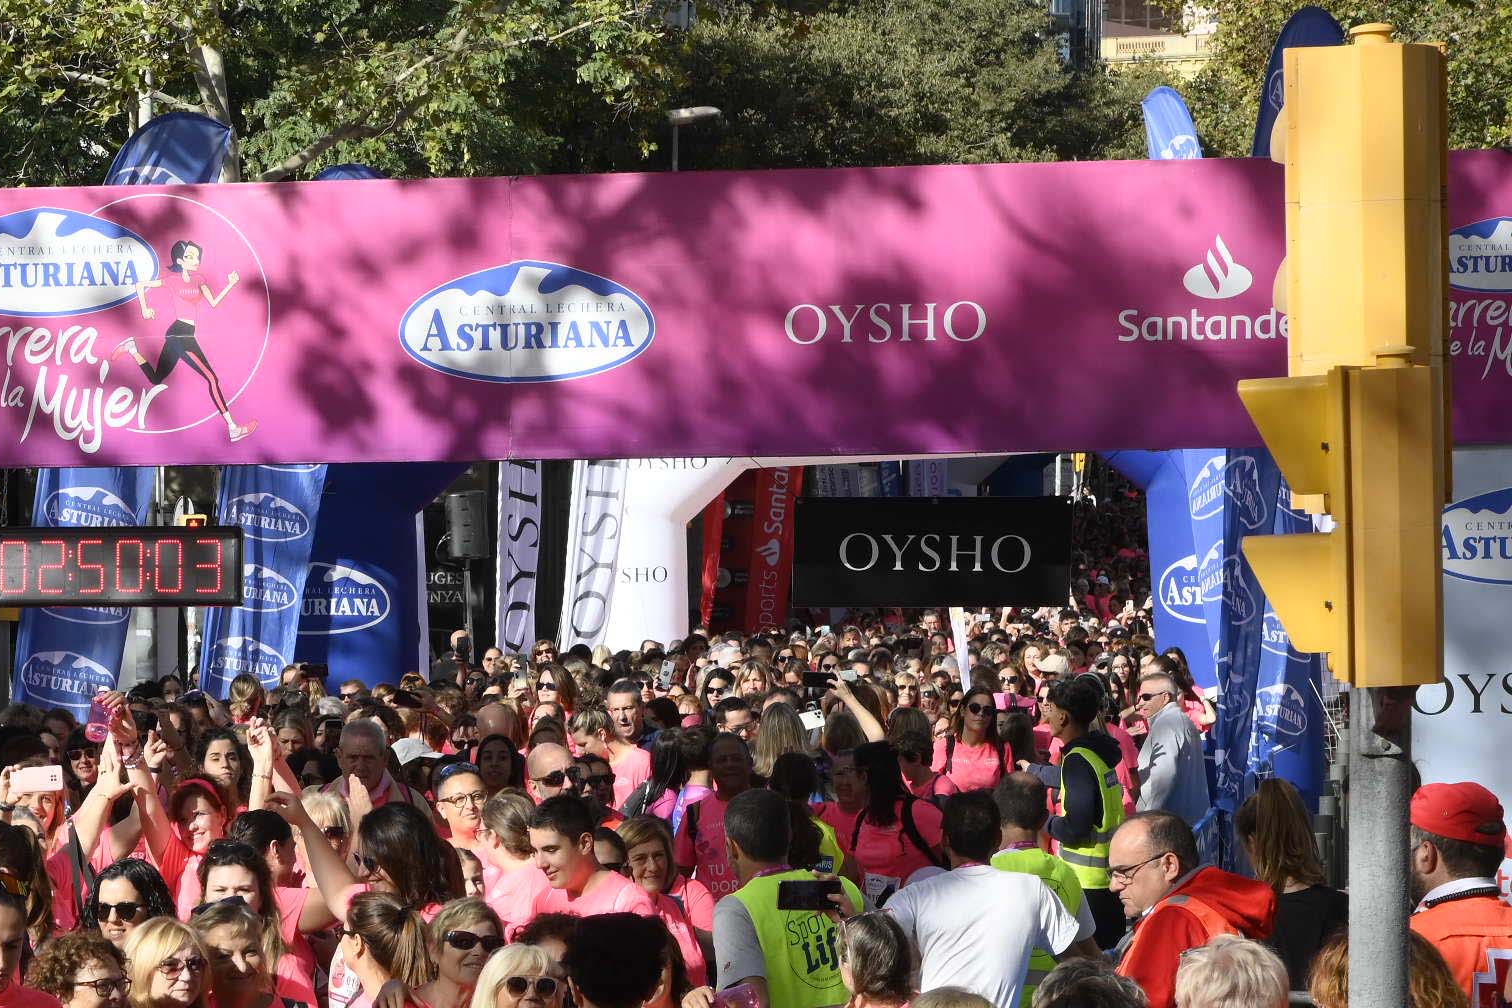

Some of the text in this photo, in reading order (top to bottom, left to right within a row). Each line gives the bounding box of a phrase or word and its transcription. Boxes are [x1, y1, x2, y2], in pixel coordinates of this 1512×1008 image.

[459, 301, 627, 315] CENTRAL LECHERA
[784, 301, 987, 345] OYSHO
[420, 308, 636, 352] ASTURIANA
[1468, 328, 1485, 355] la
[0, 368, 25, 408] la
[20, 360, 168, 453] Mujer
[0, 539, 222, 594] 02:50:03
[839, 533, 1032, 573] OYSHO
[613, 564, 668, 584] SHO
[708, 864, 725, 875] TU
